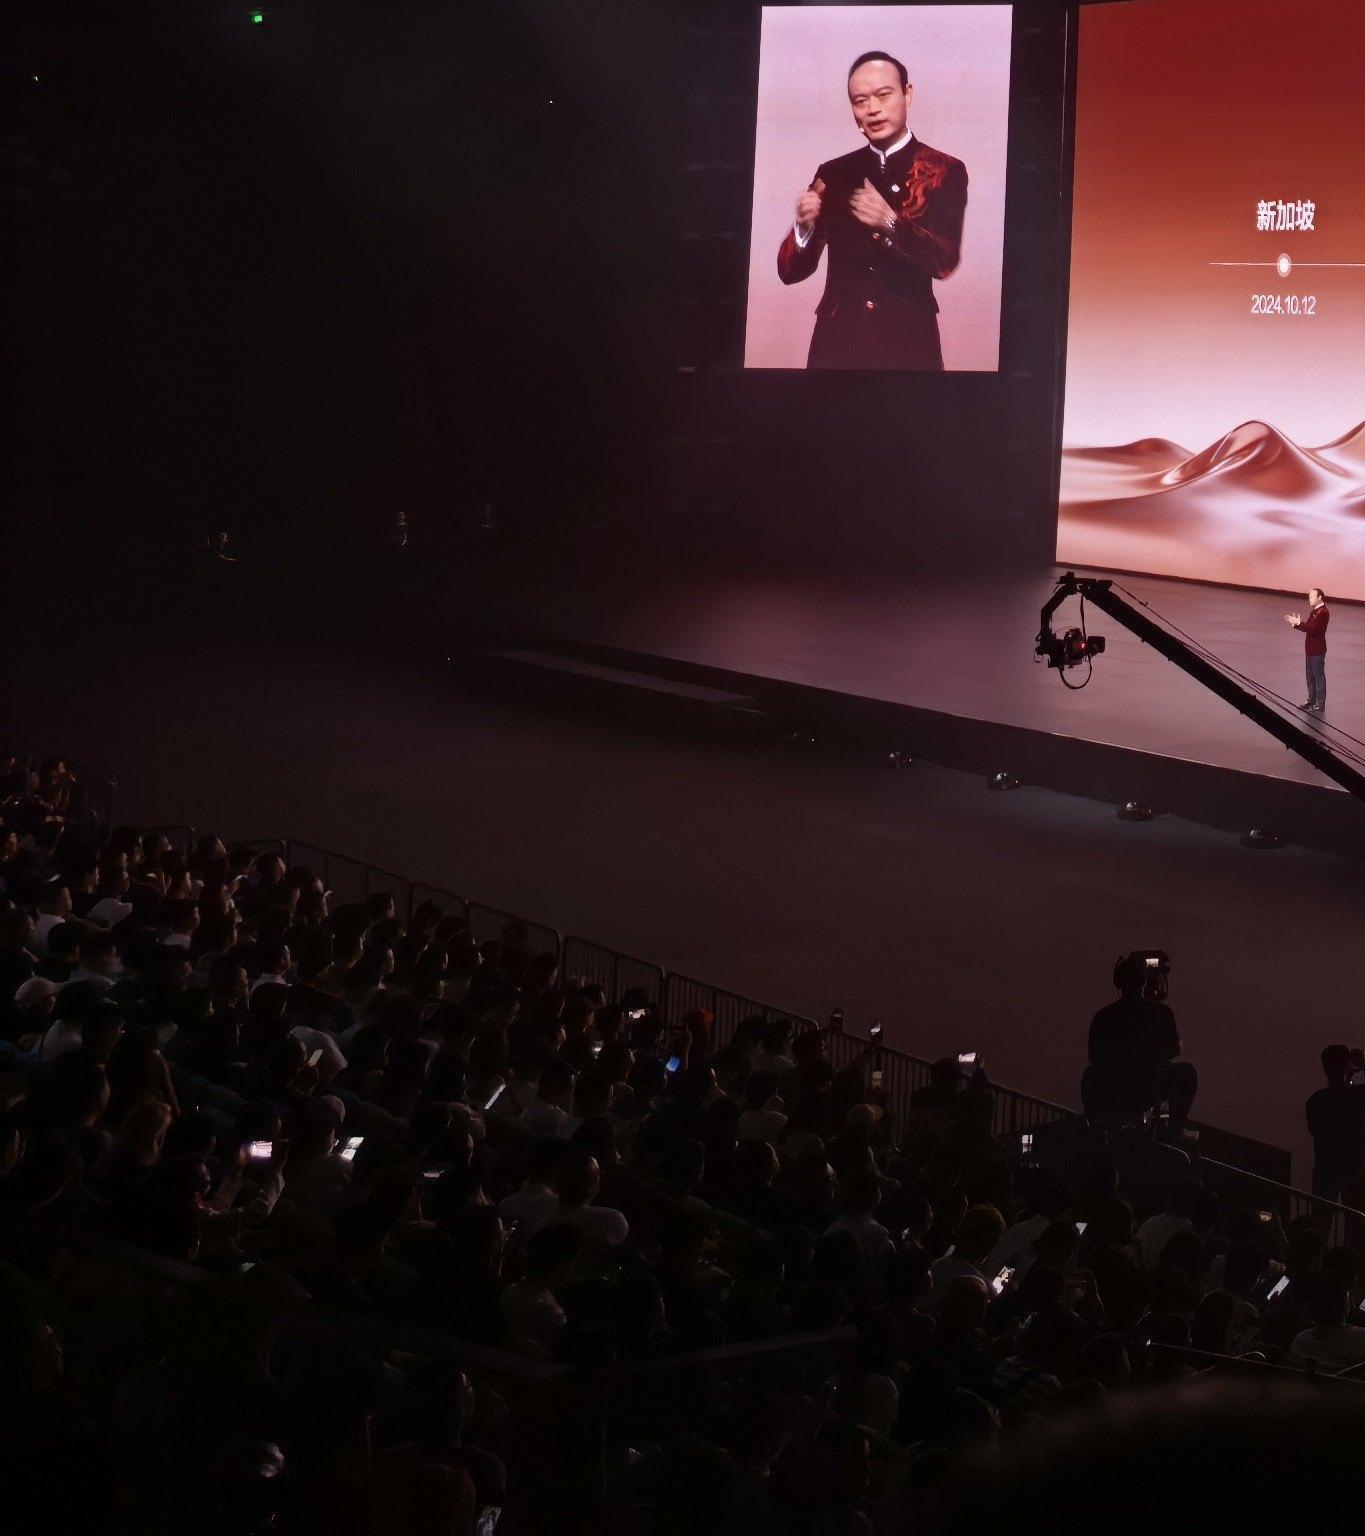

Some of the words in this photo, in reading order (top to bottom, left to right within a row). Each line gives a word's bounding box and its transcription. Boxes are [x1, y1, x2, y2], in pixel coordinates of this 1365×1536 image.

[1256, 199, 1316, 232] 新加坡
[1251, 294, 1317, 315] 2024.10.12
